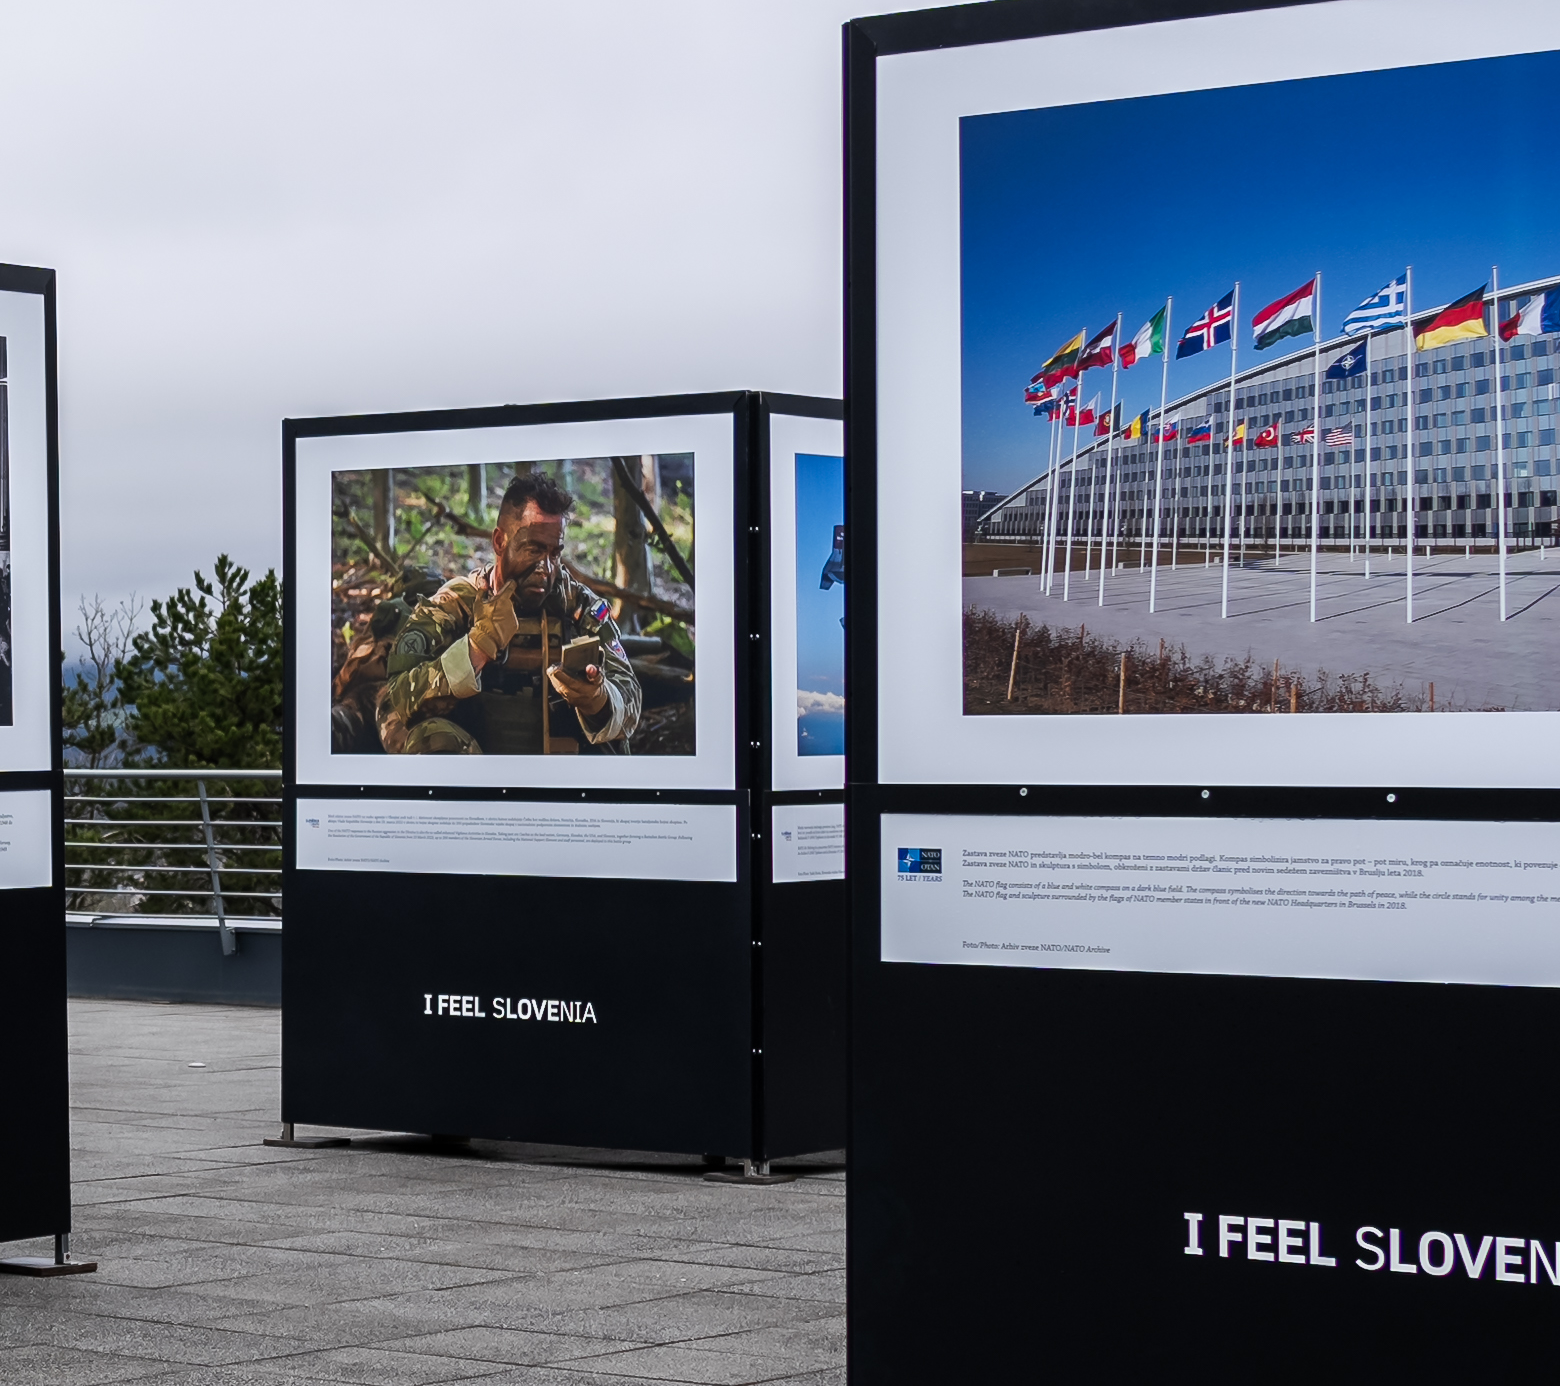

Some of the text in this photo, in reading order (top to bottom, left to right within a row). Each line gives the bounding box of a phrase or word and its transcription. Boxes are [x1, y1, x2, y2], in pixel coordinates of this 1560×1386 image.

[962, 849, 987, 857] Zastava
[1008, 850, 1029, 858] NATO
[1030, 850, 1067, 861] predstavlja
[1067, 851, 1103, 859] modro-bel
[1104, 852, 1131, 862] kompas
[1166, 853, 1188, 861] modri
[1218, 854, 1248, 864] Kompas
[1289, 856, 1319, 866] jamstvo
[1330, 858, 1351, 866] pravo
[1352, 858, 1366, 867] pot
[1373, 858, 1387, 867] pot
[1410, 858, 1428, 868] krog
[1523, 861, 1558, 871] povezuje
[962, 859, 987, 867] Zastava
[1008, 860, 1029, 868] NATO
[1038, 860, 1070, 871] skulptura
[1233, 865, 1250, 875] pred
[1251, 866, 1275, 874] novim
[1358, 868, 1385, 878] Bruslju
[1386, 868, 1401, 876] leta
[962, 879, 973, 887] The
[973, 879, 994, 888] NATO
[995, 880, 1007, 890] flag
[1008, 880, 1032, 889] consists
[1046, 881, 1060, 889] blue
[1061, 882, 1074, 890] and
[1074, 882, 1093, 890] white
[1093, 884, 1120, 893] compass
[1136, 883, 1151, 892] dark
[1152, 884, 1167, 892] blue
[1185, 885, 1197, 893] The
[1198, 887, 1226, 896] compass
[1227, 886, 1263, 896] symbolises
[1264, 887, 1276, 895] the
[1276, 887, 1306, 896] direction
[1307, 888, 1336, 896] towards
[1336, 889, 1348, 897] the
[1349, 889, 1366, 899] path
[1398, 890, 1418, 899] while
[1418, 891, 1431, 899] the
[1431, 891, 1451, 900] circle
[1451, 892, 1476, 900] stands
[1476, 892, 1488, 903] for
[1488, 893, 1509, 903] unity
[1509, 895, 1535, 904] among
[1536, 894, 1549, 902] the
[962, 889, 973, 897] The
[973, 890, 994, 898] NATO
[995, 890, 1008, 901] flag
[1008, 891, 1021, 899] and
[1021, 891, 1050, 901] sculpture
[1050, 892, 1088, 900] surrounded
[1097, 893, 1108, 901] the
[1108, 893, 1125, 904] flags
[1134, 894, 1155, 902] NATO
[1155, 895, 1183, 903] member
[1212, 896, 1230, 906] front
[1239, 897, 1250, 905] the
[1266, 898, 1289, 906] NATO
[1290, 898, 1338, 909] Headquarters
[1347, 900, 1376, 909] Brussels
[1000, 942, 1019, 950] Arhiv
[1040, 943, 1085, 953] NATO/NATO
[1085, 945, 1110, 954] Archive
[424, 994, 598, 1024] I FEEL SLOVENIA
[1184, 1212, 1204, 1256] I
[1218, 1214, 1336, 1266] FEEL
